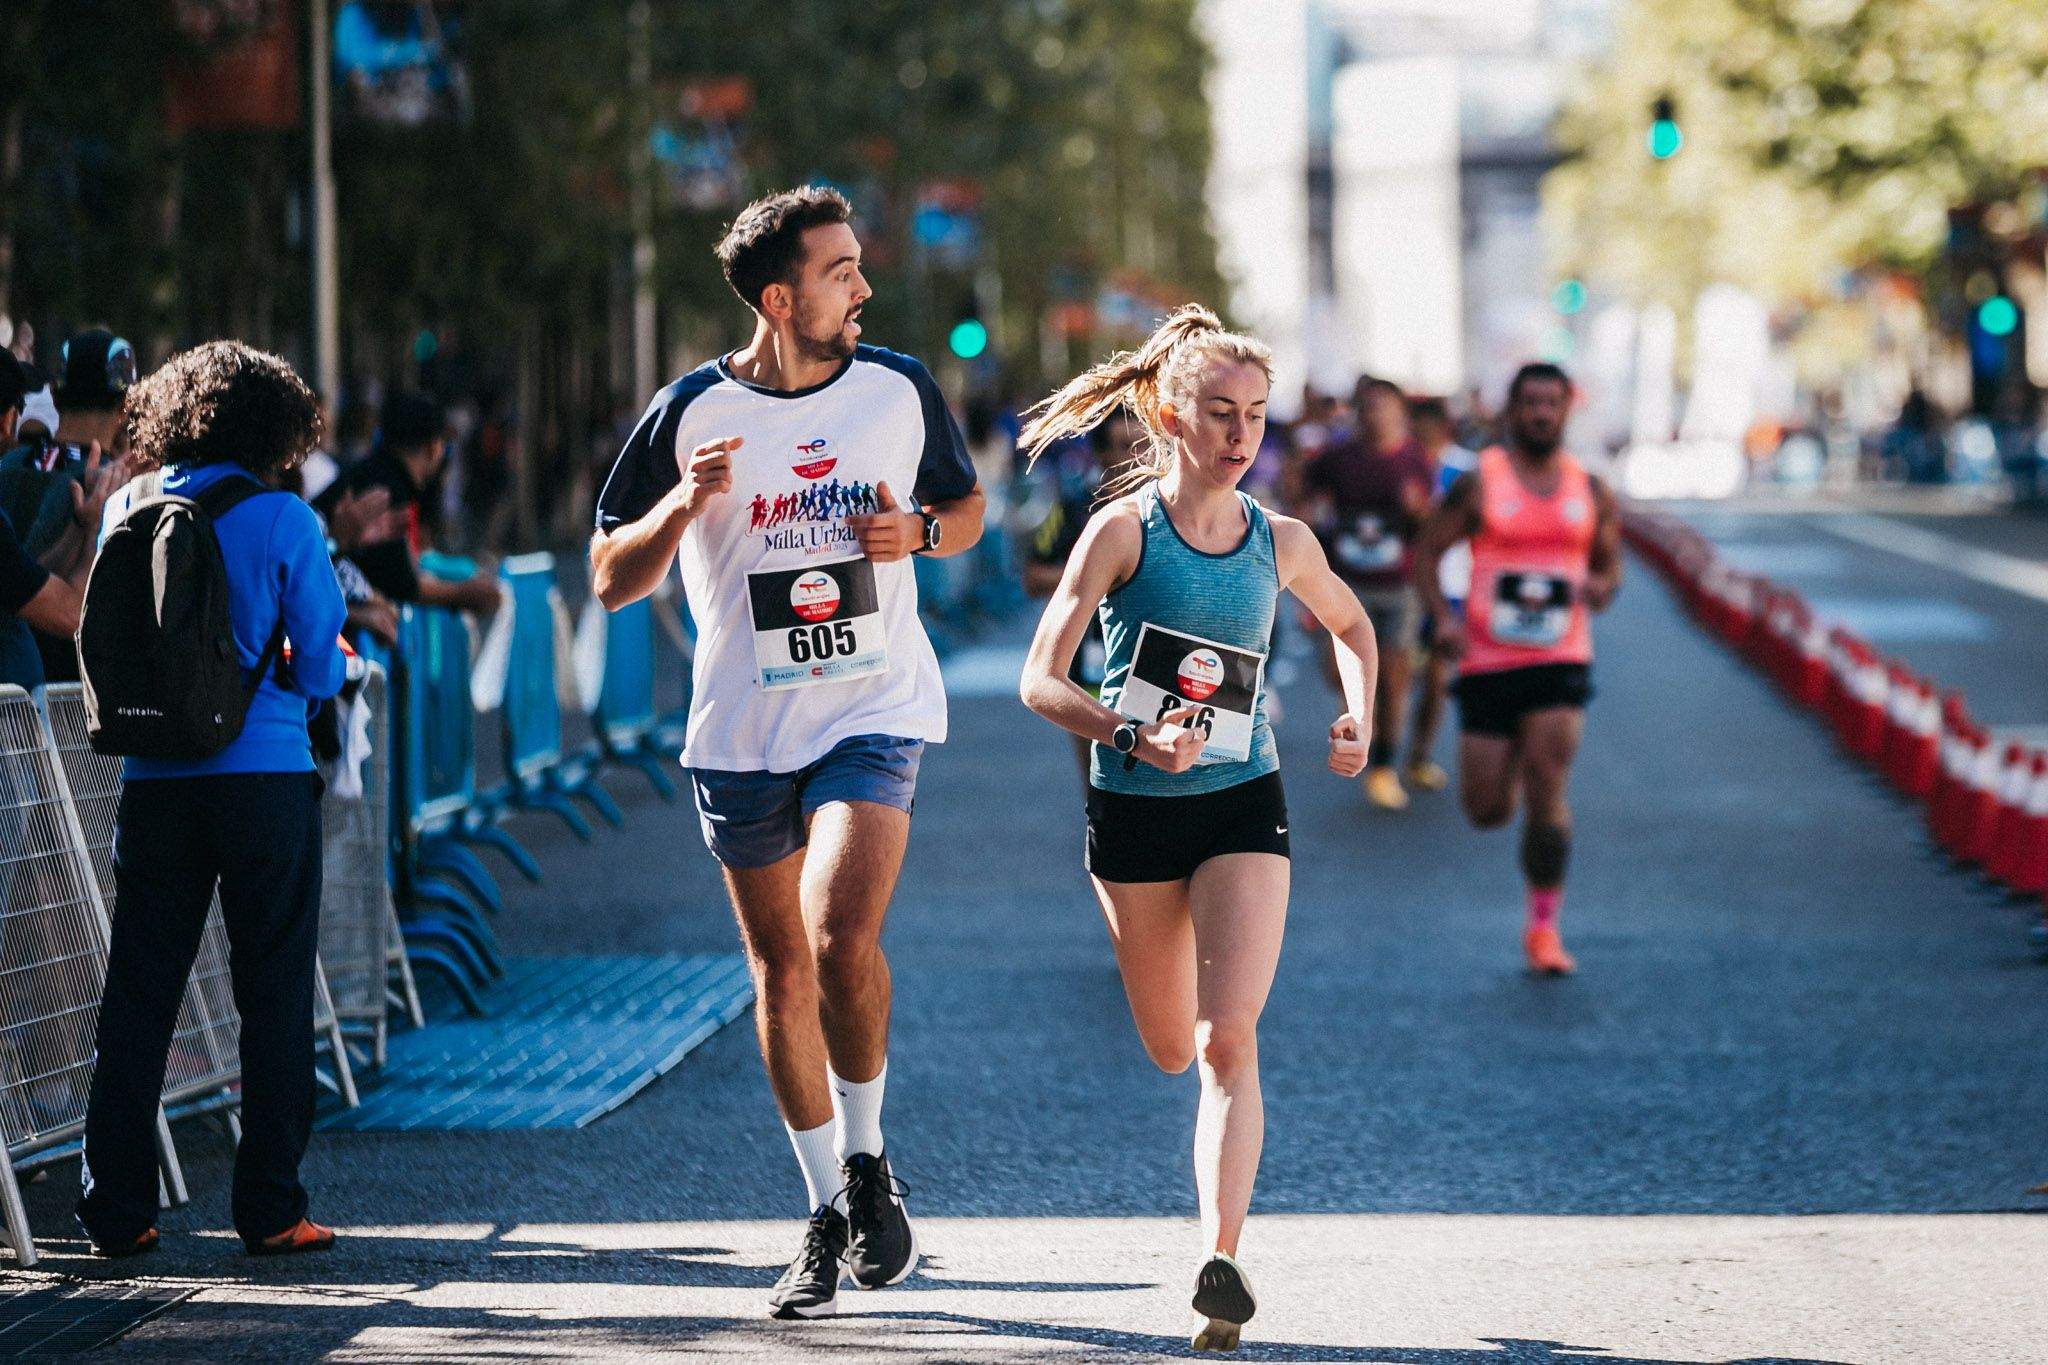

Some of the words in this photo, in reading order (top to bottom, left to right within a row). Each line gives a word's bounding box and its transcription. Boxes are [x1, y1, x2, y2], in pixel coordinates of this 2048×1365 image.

[764, 528, 806, 551] Milla
[810, 522, 857, 546] Urba
[804, 543, 832, 556] Madrid
[788, 621, 857, 663] 605
[774, 671, 804, 680] MADRID
